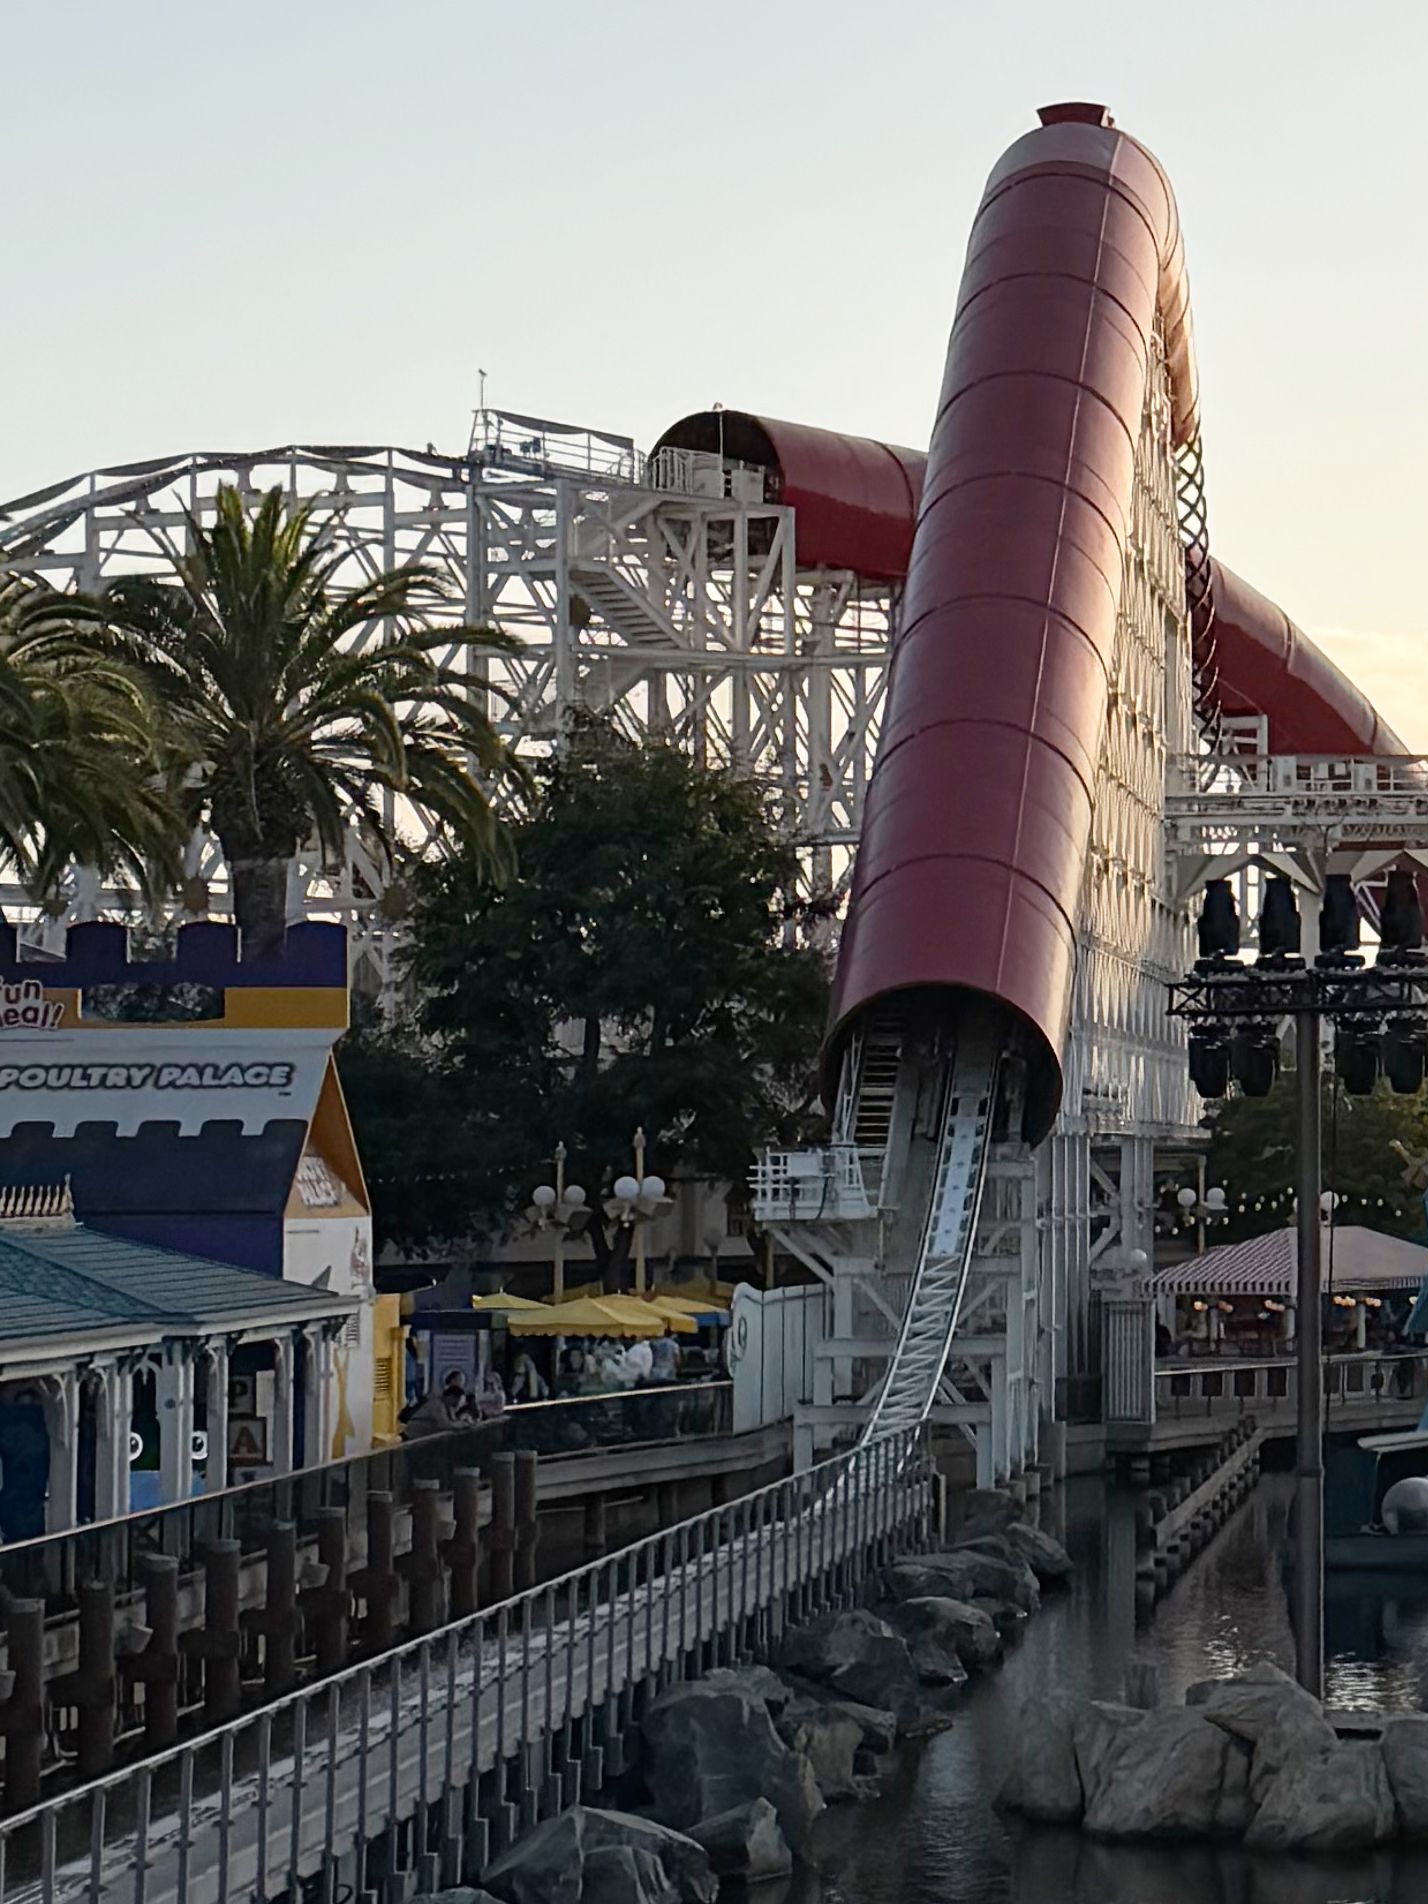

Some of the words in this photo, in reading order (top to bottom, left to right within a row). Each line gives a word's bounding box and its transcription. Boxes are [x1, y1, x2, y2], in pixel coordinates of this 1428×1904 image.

[0, 979, 41, 1004] un
[0, 1004, 63, 1027] eal!
[0, 1064, 151, 1089] POULTRY
[156, 1063, 293, 1088] PALACE
